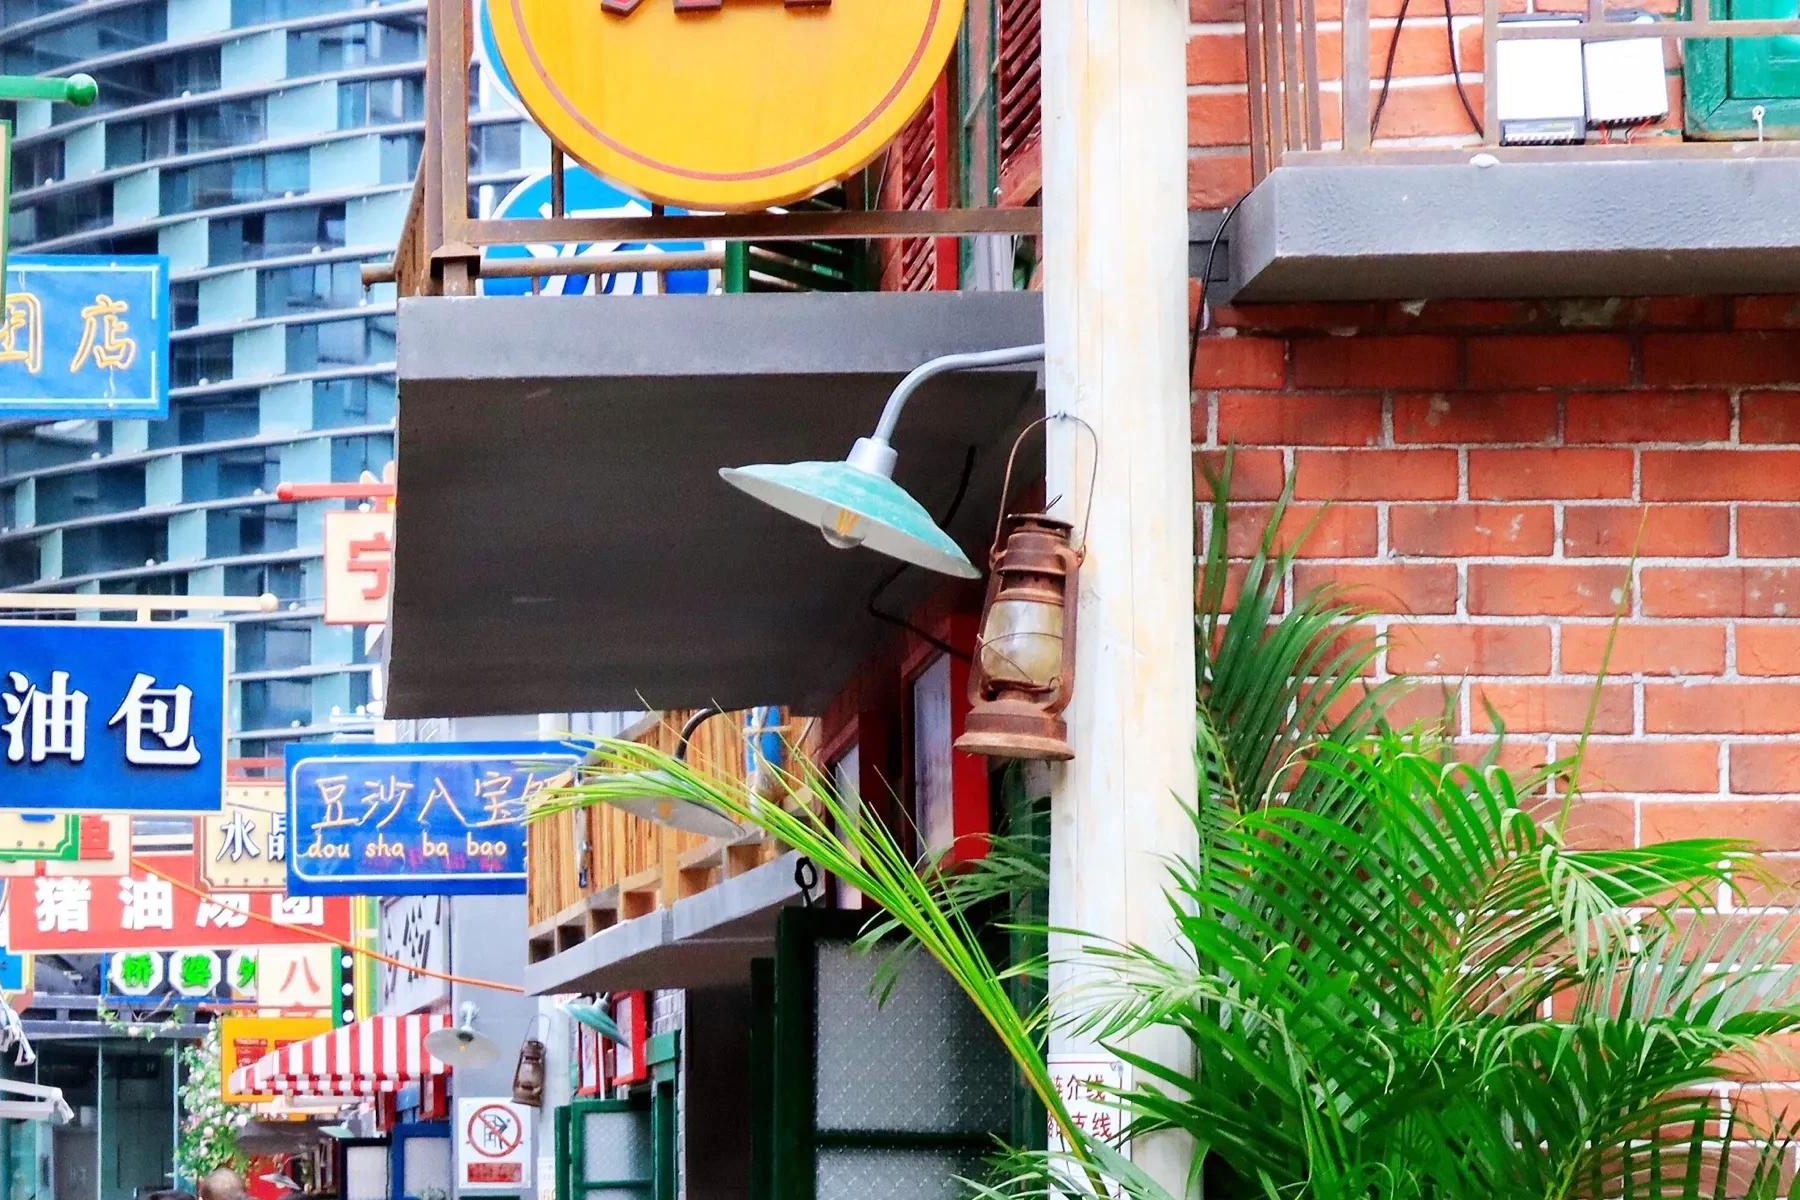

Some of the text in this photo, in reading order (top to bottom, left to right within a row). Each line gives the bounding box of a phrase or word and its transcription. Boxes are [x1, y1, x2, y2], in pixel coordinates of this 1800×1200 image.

[307, 831, 508, 859] dou sha ba bao
